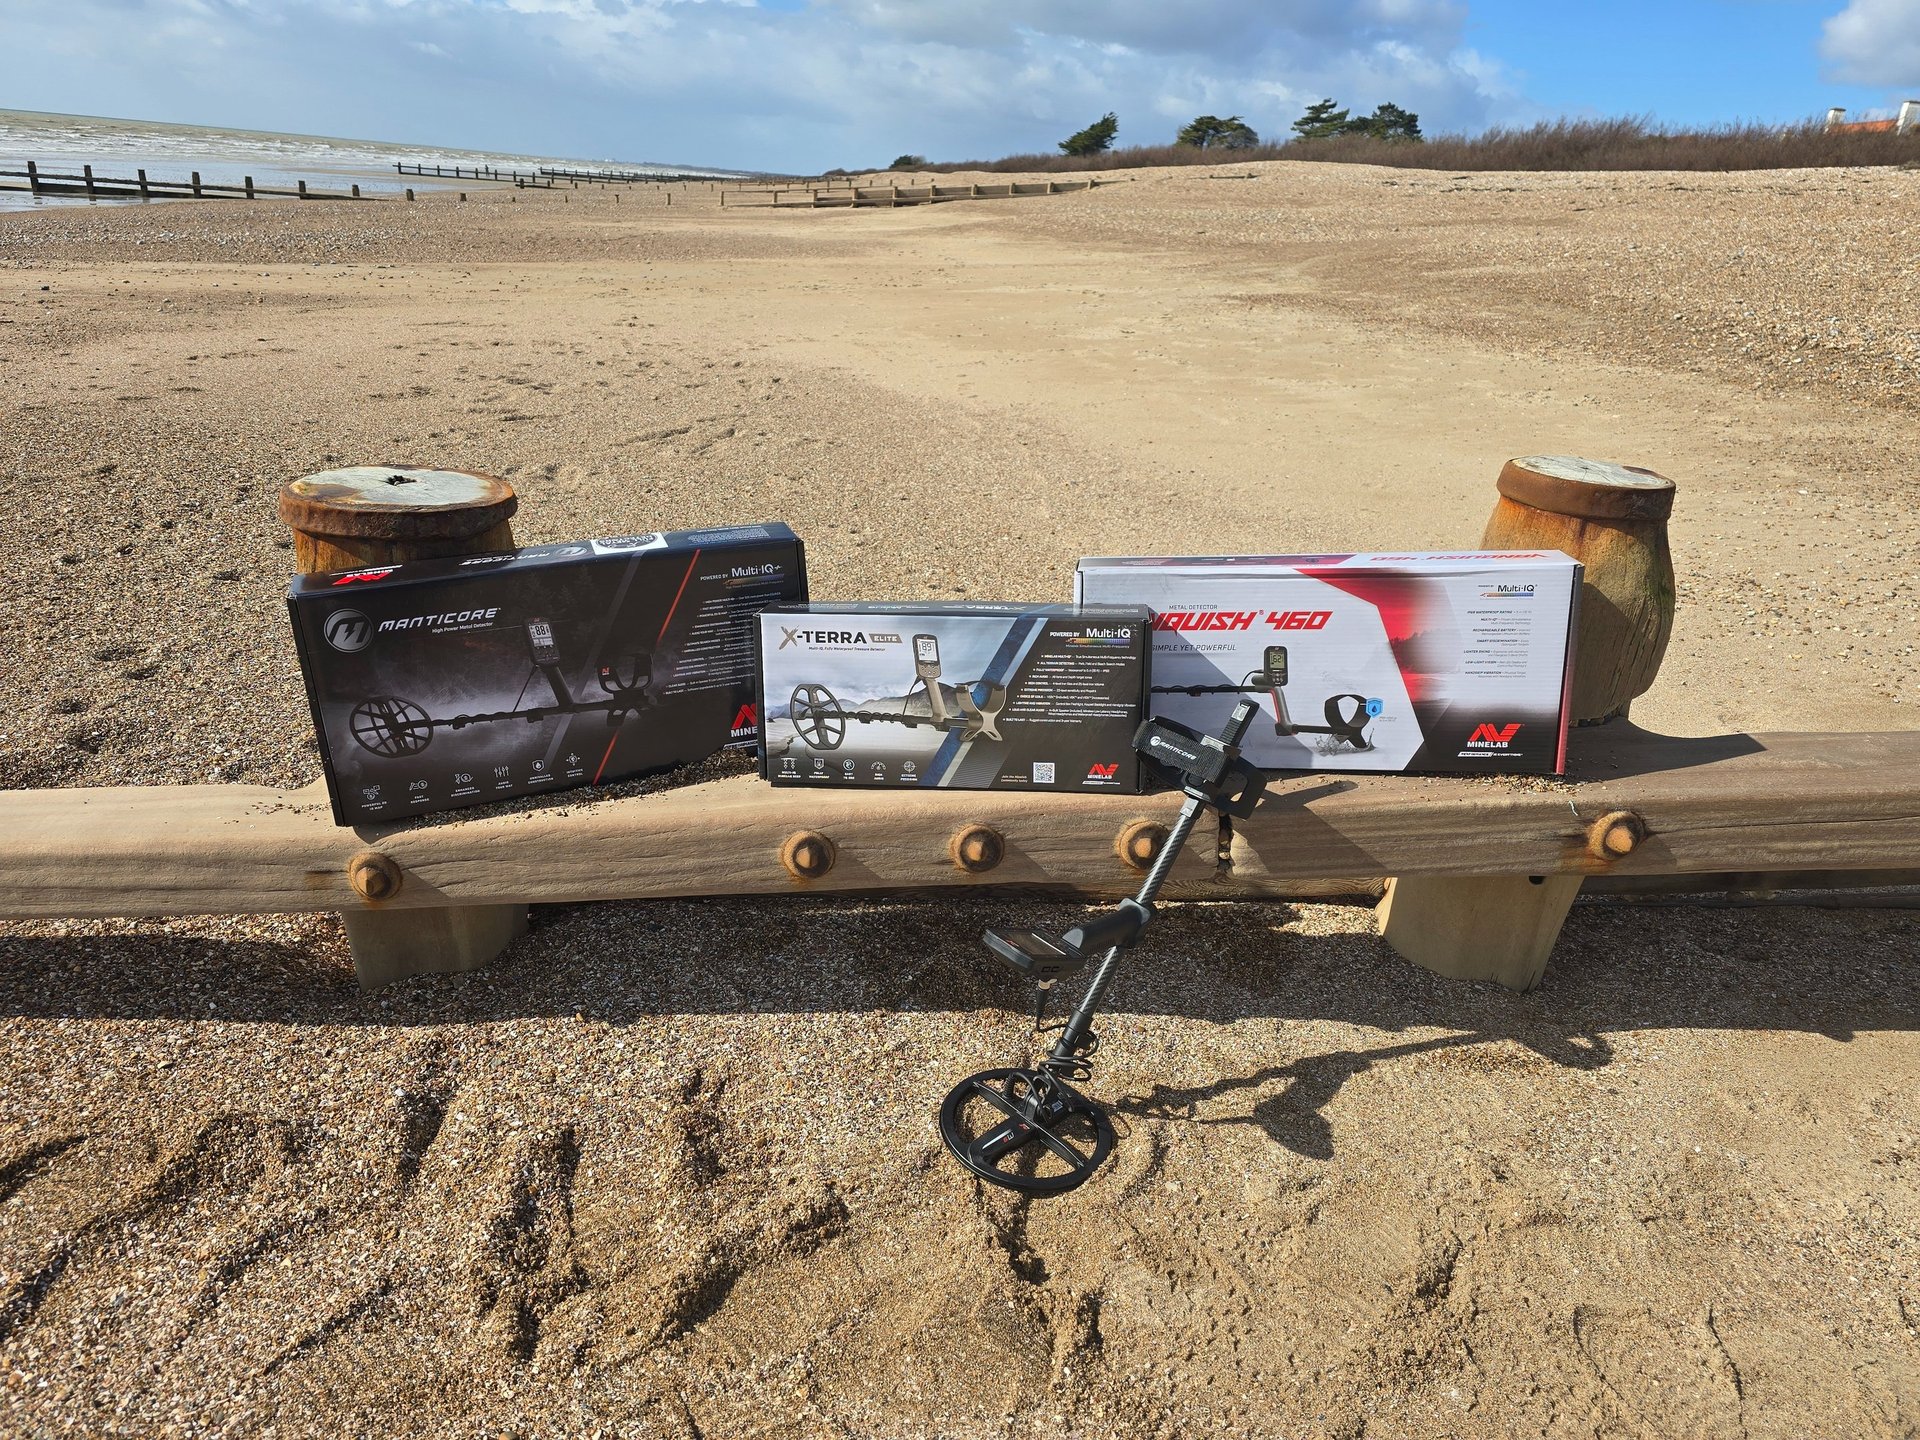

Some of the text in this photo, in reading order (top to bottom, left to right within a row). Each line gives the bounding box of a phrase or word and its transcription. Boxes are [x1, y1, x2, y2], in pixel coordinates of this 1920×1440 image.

[378, 608, 498, 632] MANTICORE
[473, 621, 493, 629] Detector
[1264, 611, 1334, 630] 460
[779, 625, 867, 650] X-TERRA
